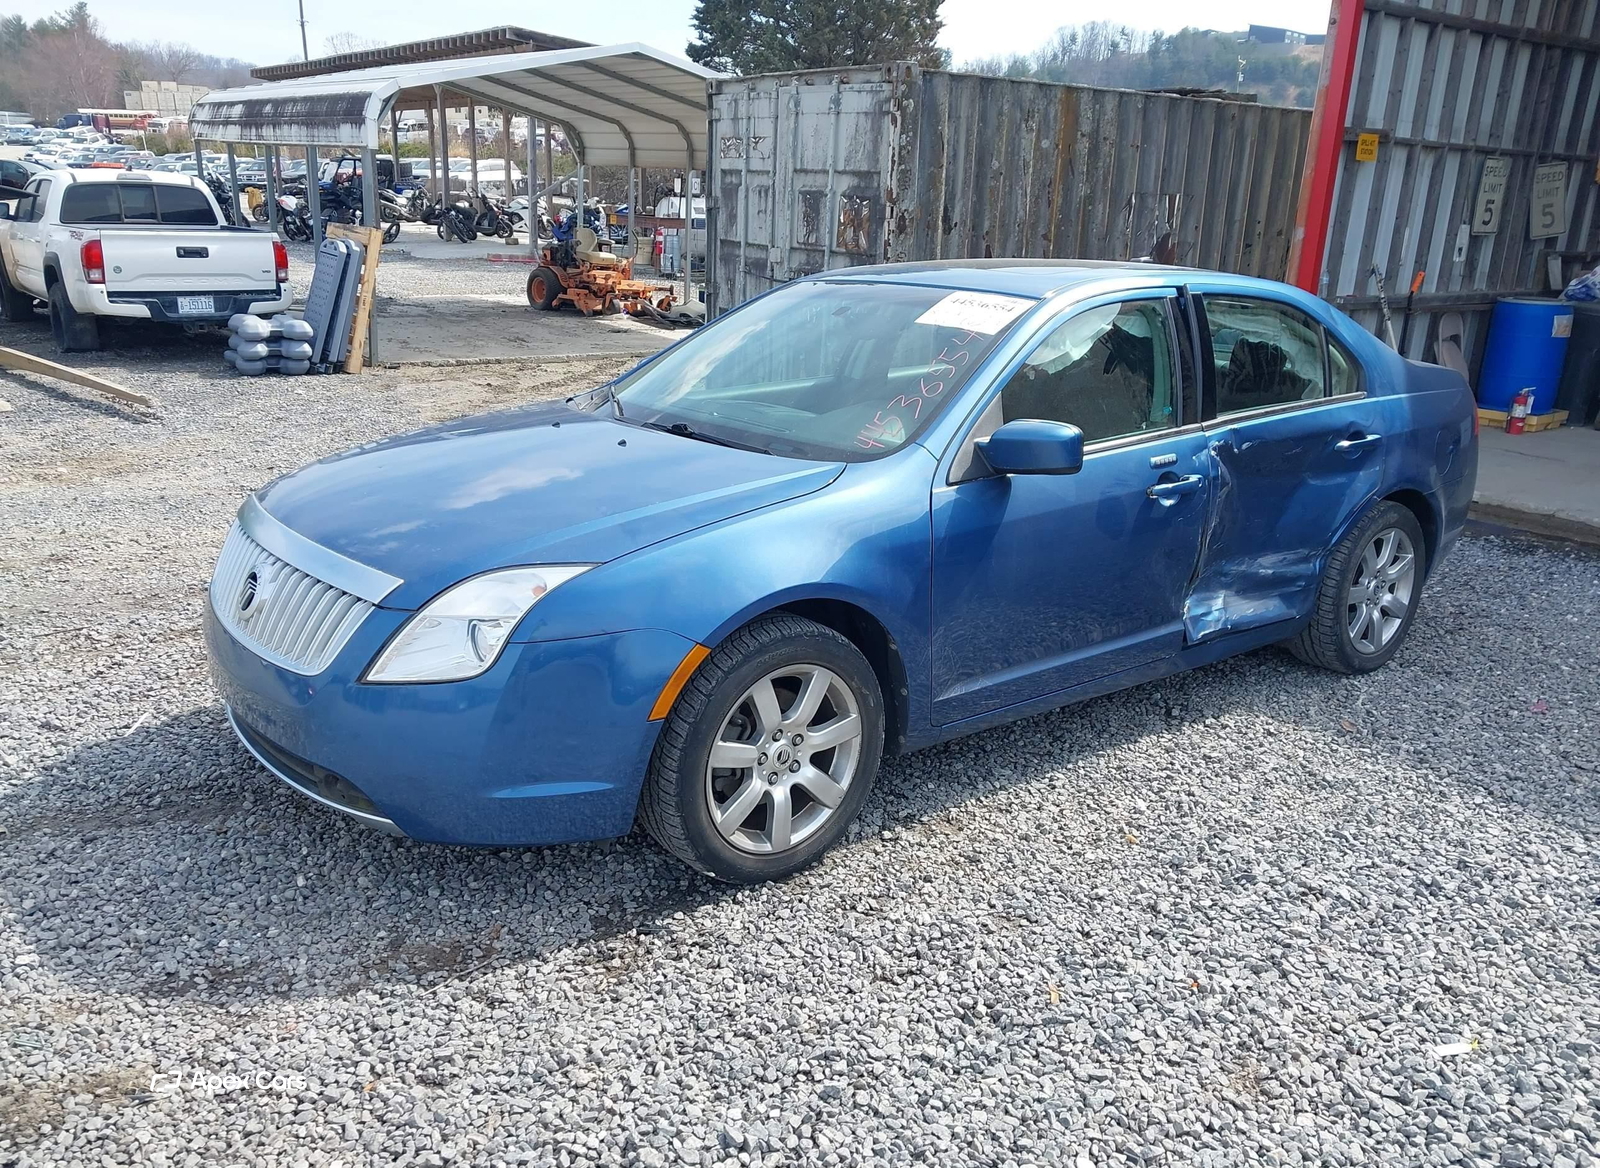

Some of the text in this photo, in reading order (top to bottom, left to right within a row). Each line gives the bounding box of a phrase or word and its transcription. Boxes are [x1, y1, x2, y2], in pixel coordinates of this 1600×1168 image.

[1484, 165, 1508, 178] SPEED
[1535, 171, 1564, 184] SPEED
[1483, 183, 1503, 193] LIMIT
[1537, 187, 1560, 199] LIMIT
[1481, 199, 1495, 226] 5
[1541, 203, 1555, 229] 5
